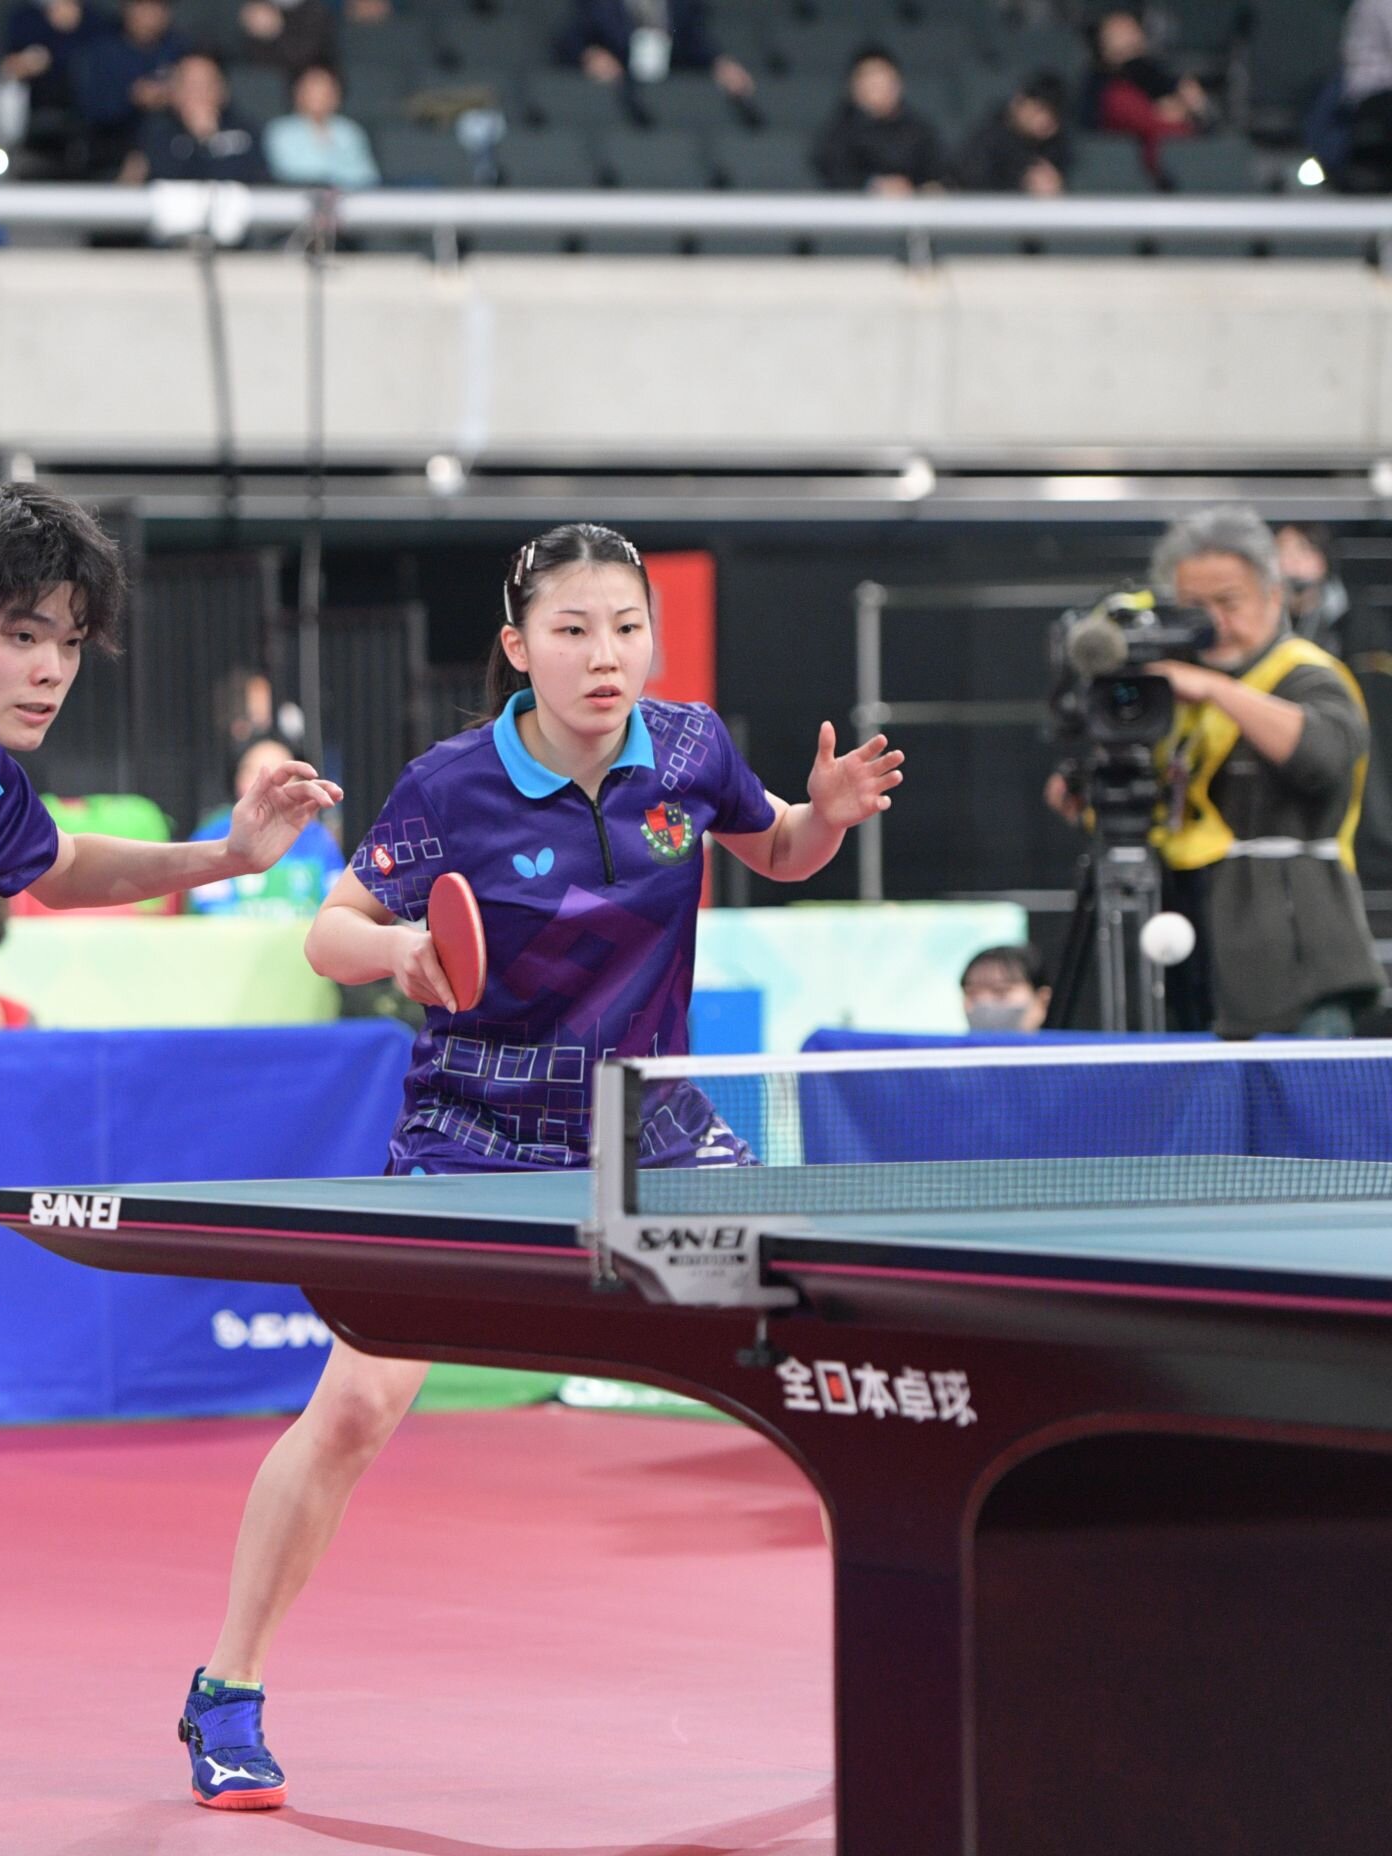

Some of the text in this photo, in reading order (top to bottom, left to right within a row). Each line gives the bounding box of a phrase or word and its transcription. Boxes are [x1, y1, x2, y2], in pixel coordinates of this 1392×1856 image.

[776, 1356, 978, 1428] 全日本卓球
